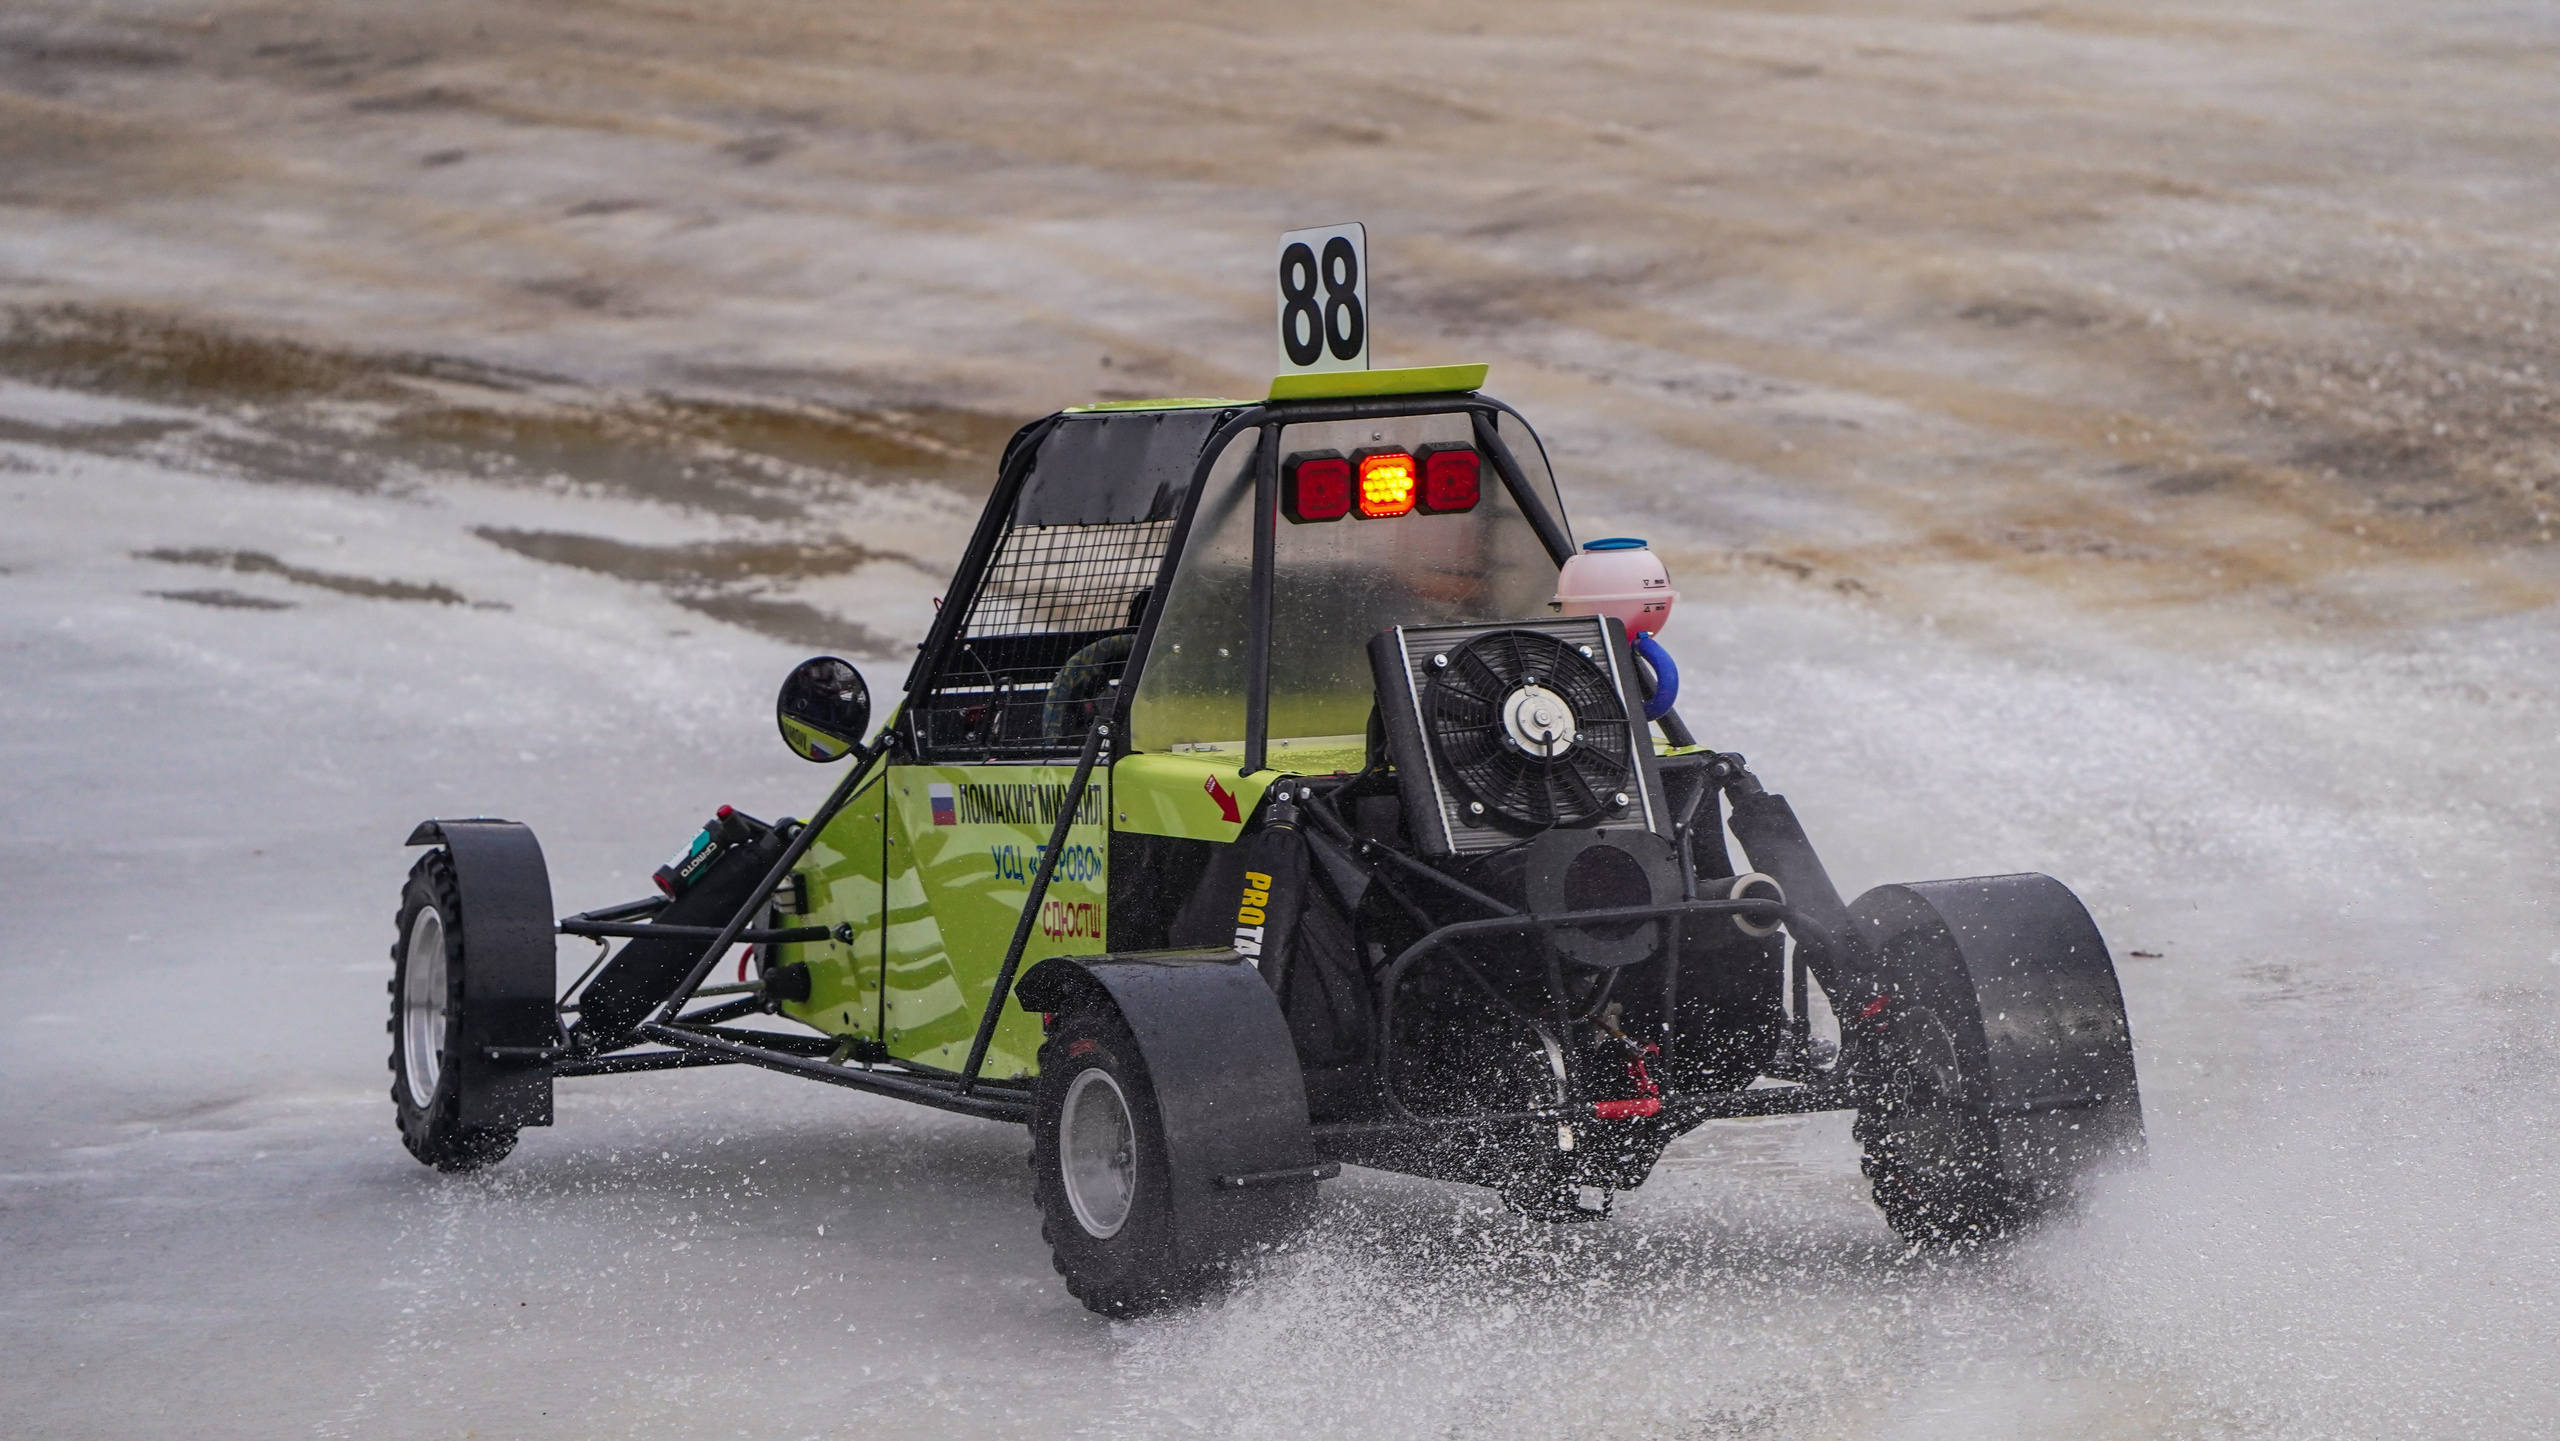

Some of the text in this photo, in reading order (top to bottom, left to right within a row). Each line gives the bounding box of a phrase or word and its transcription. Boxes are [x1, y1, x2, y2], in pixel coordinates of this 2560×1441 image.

[1280, 236, 1364, 366] 88
[959, 784, 1036, 824] ЛОМАКИН
[680, 842, 717, 877] CFMOTO
[991, 845, 1025, 885] УСЦ
[1233, 871, 1272, 969] PROTA
